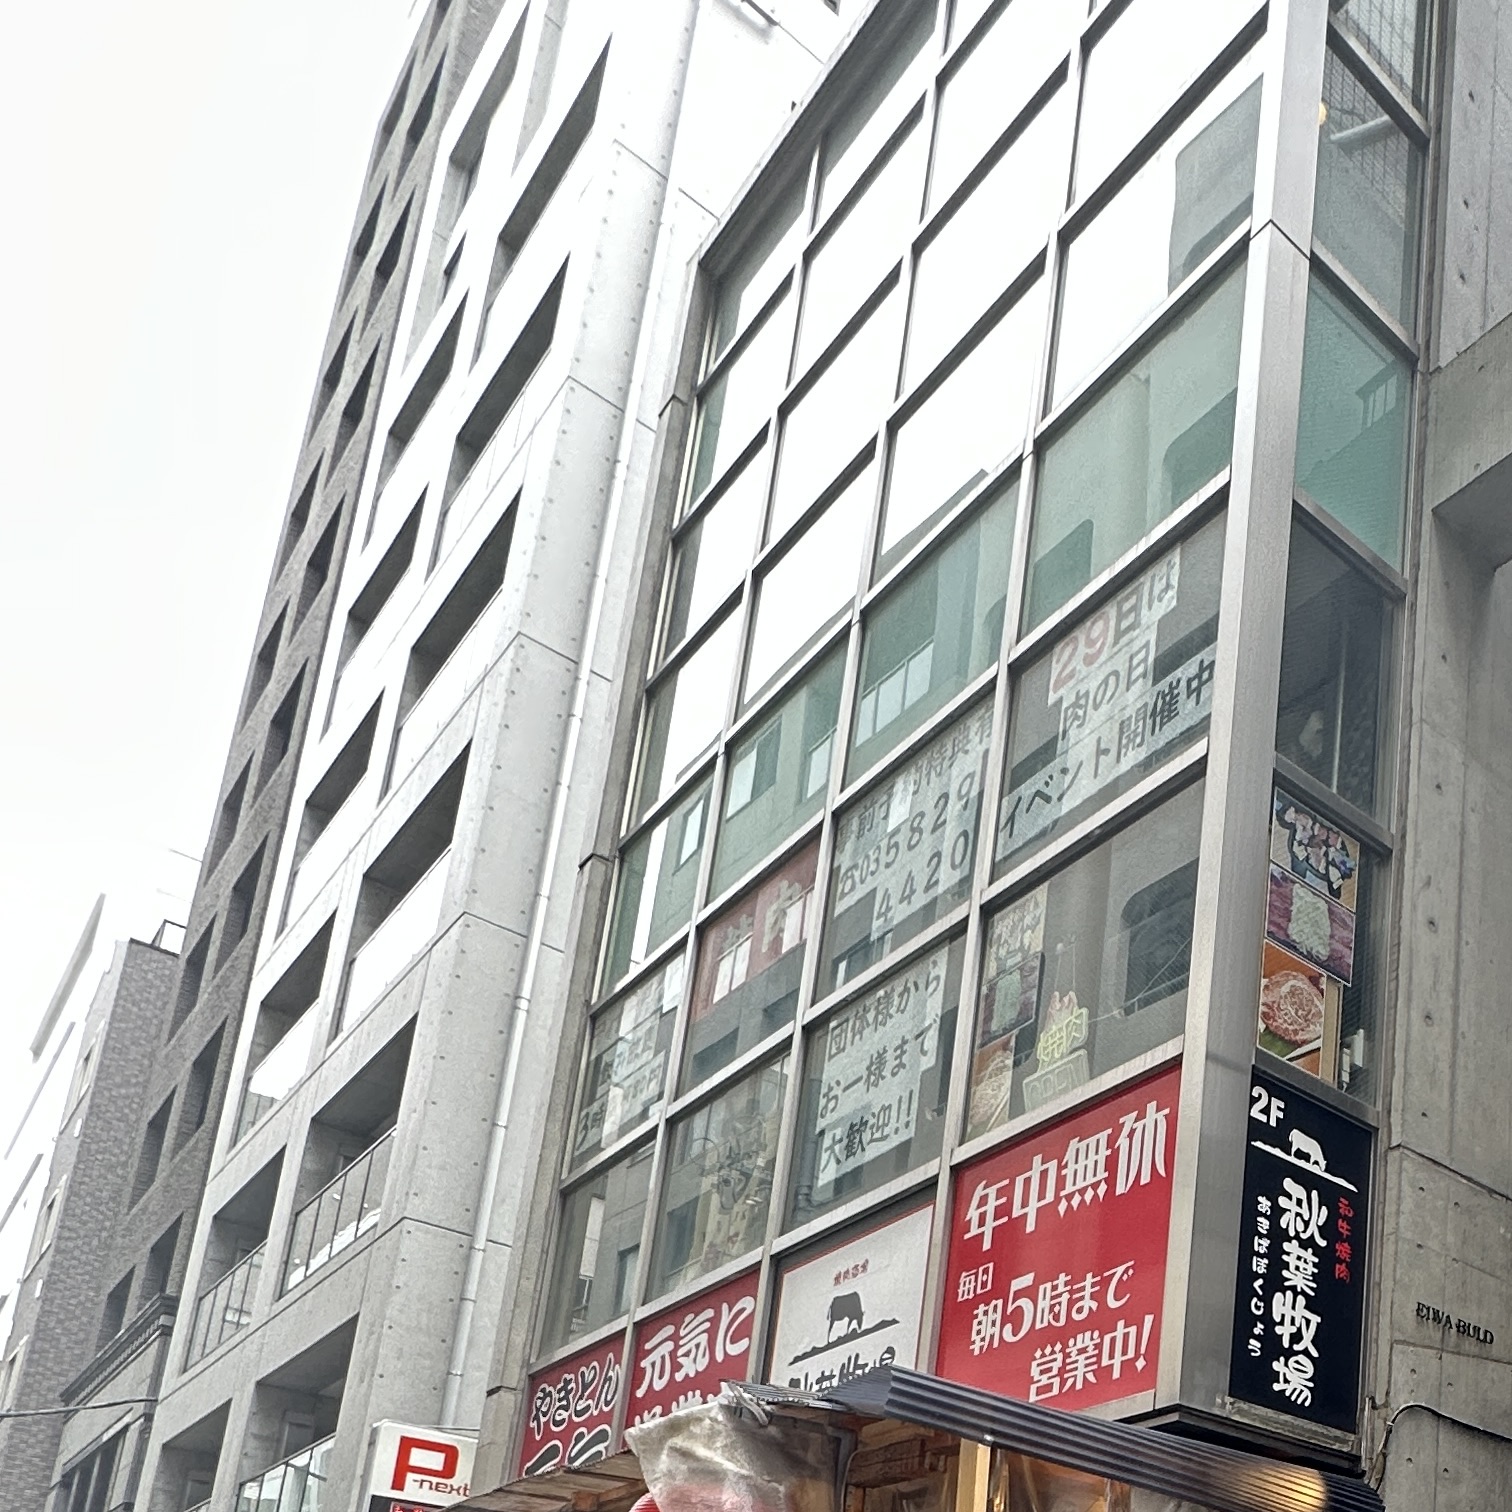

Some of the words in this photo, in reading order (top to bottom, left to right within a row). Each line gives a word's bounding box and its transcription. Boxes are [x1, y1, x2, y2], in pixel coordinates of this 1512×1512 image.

[1052, 558, 1177, 694] 29日は
[1061, 641, 1151, 741] 肉の日
[1001, 658, 1216, 839] イベント開催中
[875, 829, 971, 927] 4420
[827, 958, 942, 1063] 団体様から
[819, 1013, 940, 1121] お一様まで
[1249, 1085, 1285, 1128] 2F
[820, 1088, 914, 1174] 大歓迎!!
[962, 1100, 1171, 1252] 年中無休
[956, 1262, 994, 1303] 毎日
[969, 1259, 1136, 1356] 朝5時まで
[1271, 1177, 1329, 1408] 秋葉牧場
[1415, 1301, 1454, 1330] EIWA
[1456, 1318, 1495, 1345] BULD
[530, 1352, 622, 1441] やきとん
[635, 1295, 756, 1399] 元気に
[1028, 1314, 1155, 1402] 営業中!
